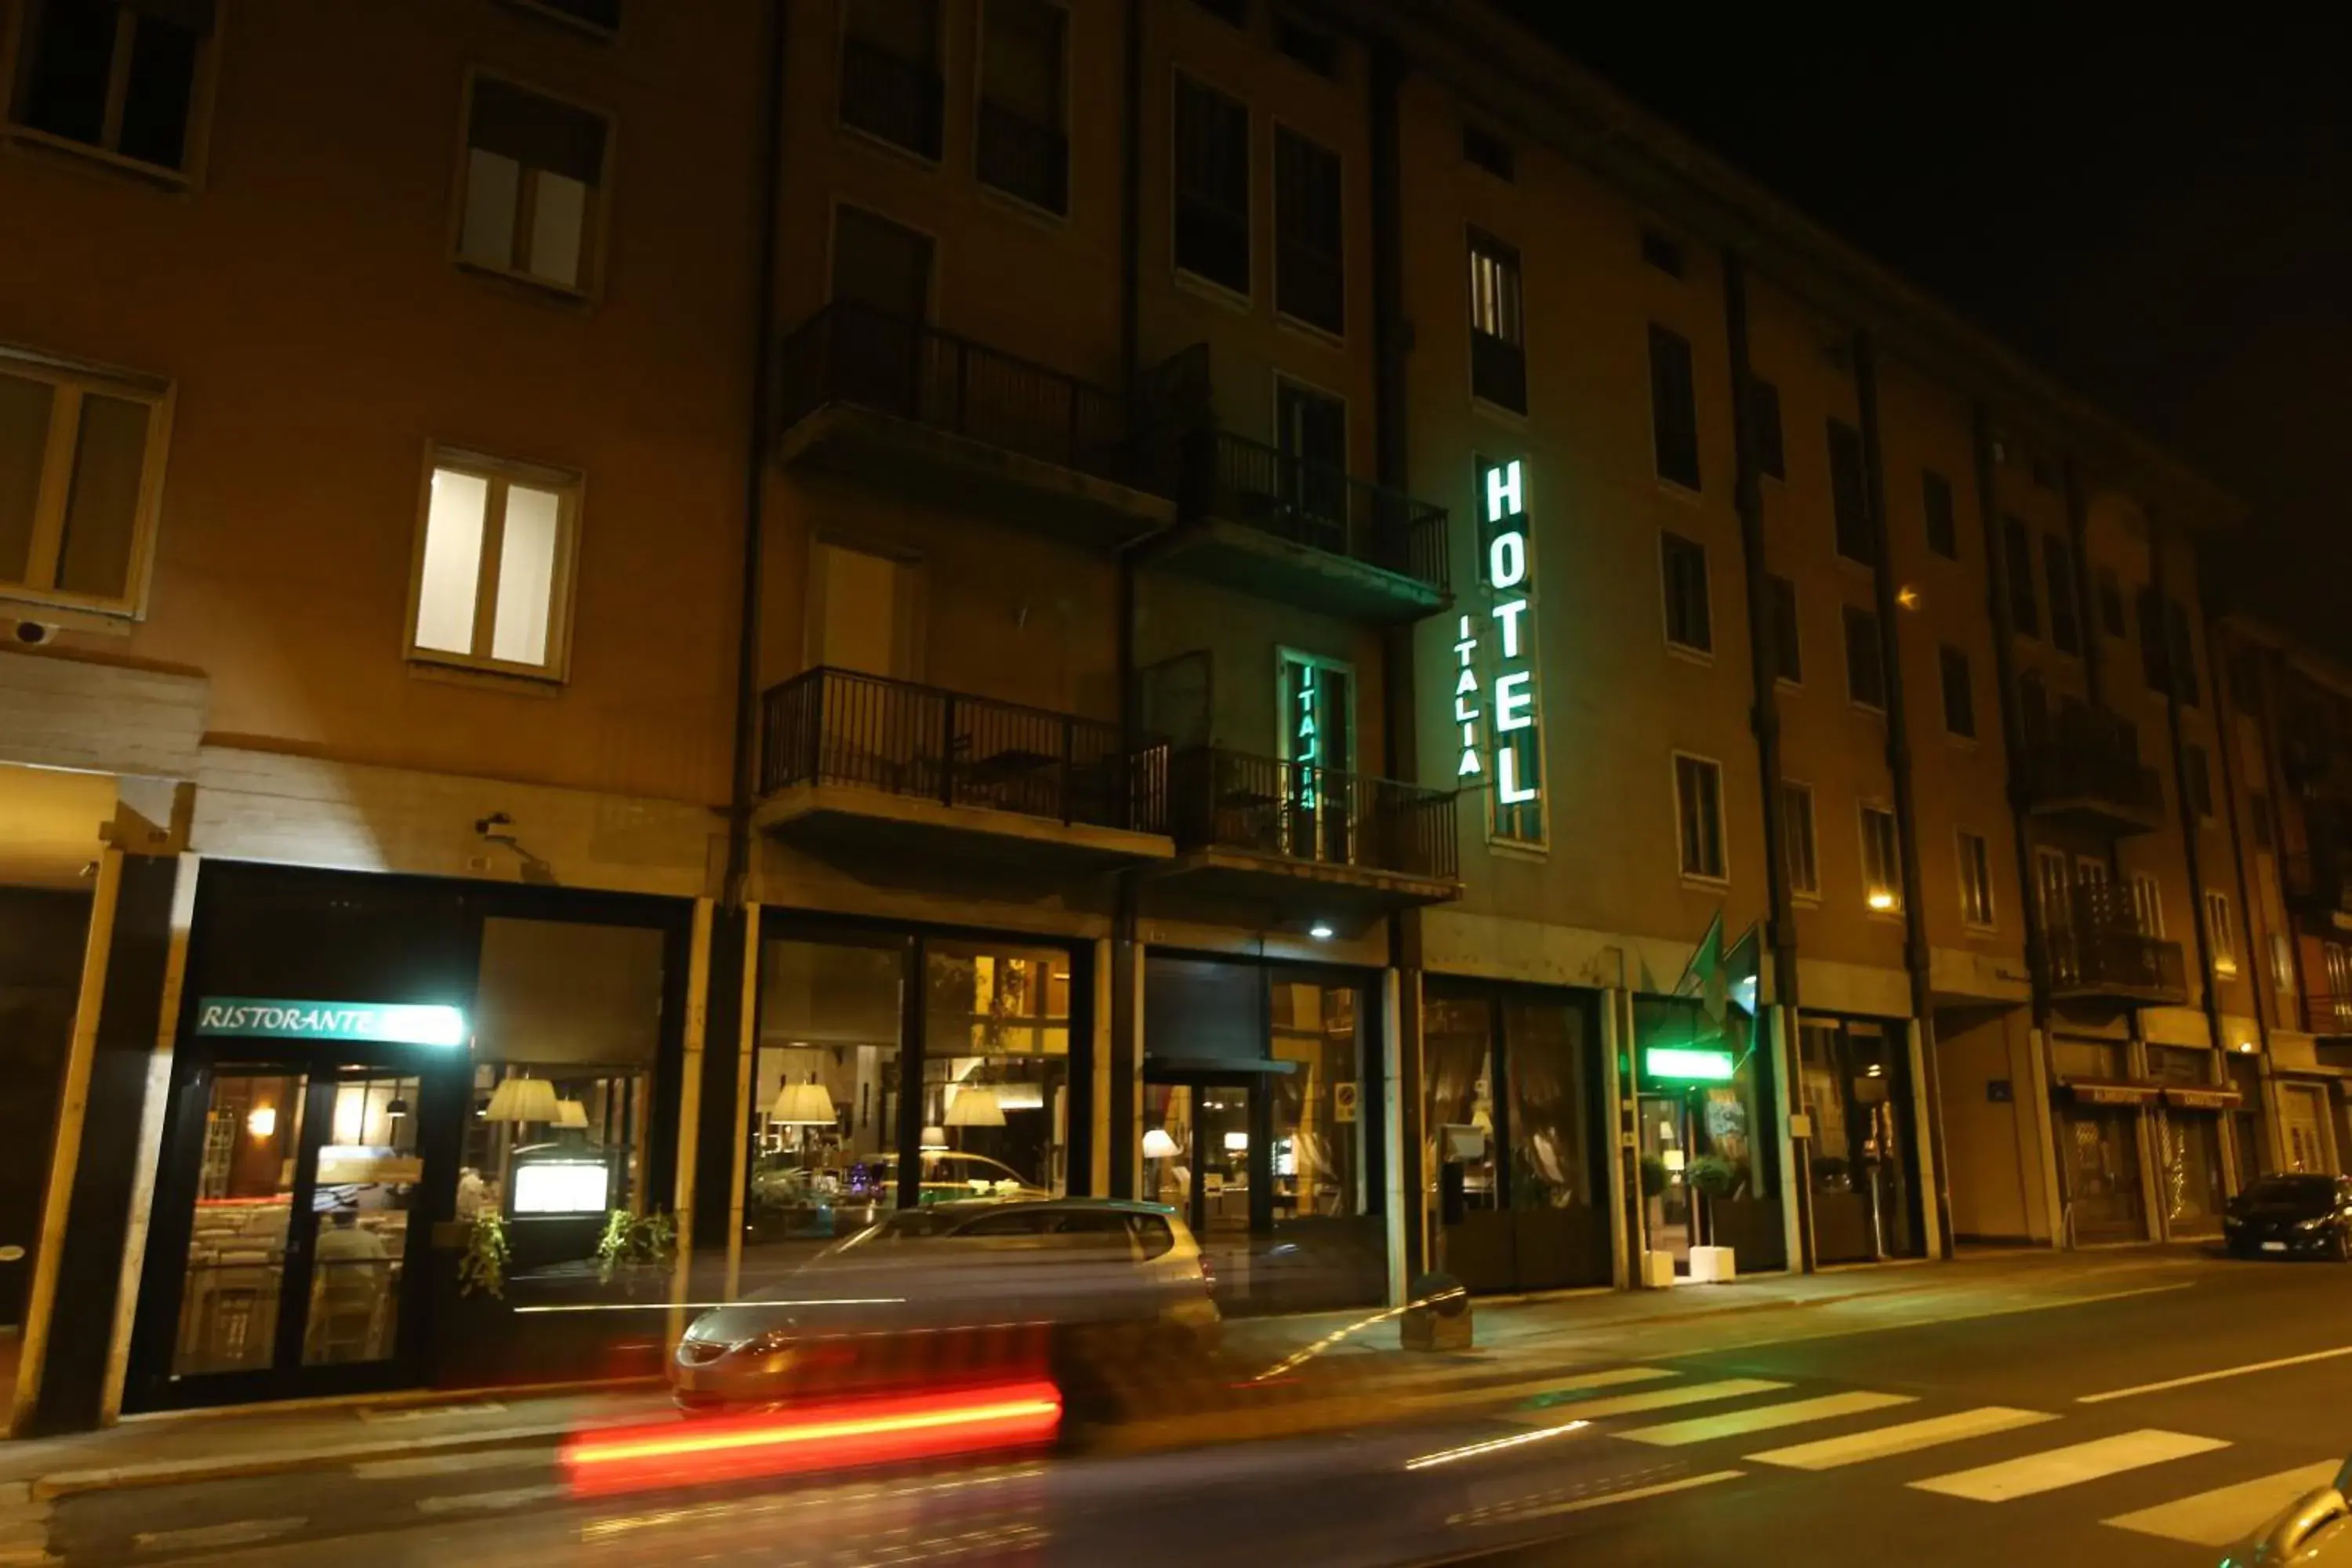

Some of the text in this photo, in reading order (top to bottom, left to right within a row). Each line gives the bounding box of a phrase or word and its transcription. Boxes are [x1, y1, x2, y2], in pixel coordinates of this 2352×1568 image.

[1454, 615, 1481, 775] ITALIA
[1487, 459, 1535, 804] HOTEL
[201, 1005, 376, 1034] RISTORANTE
